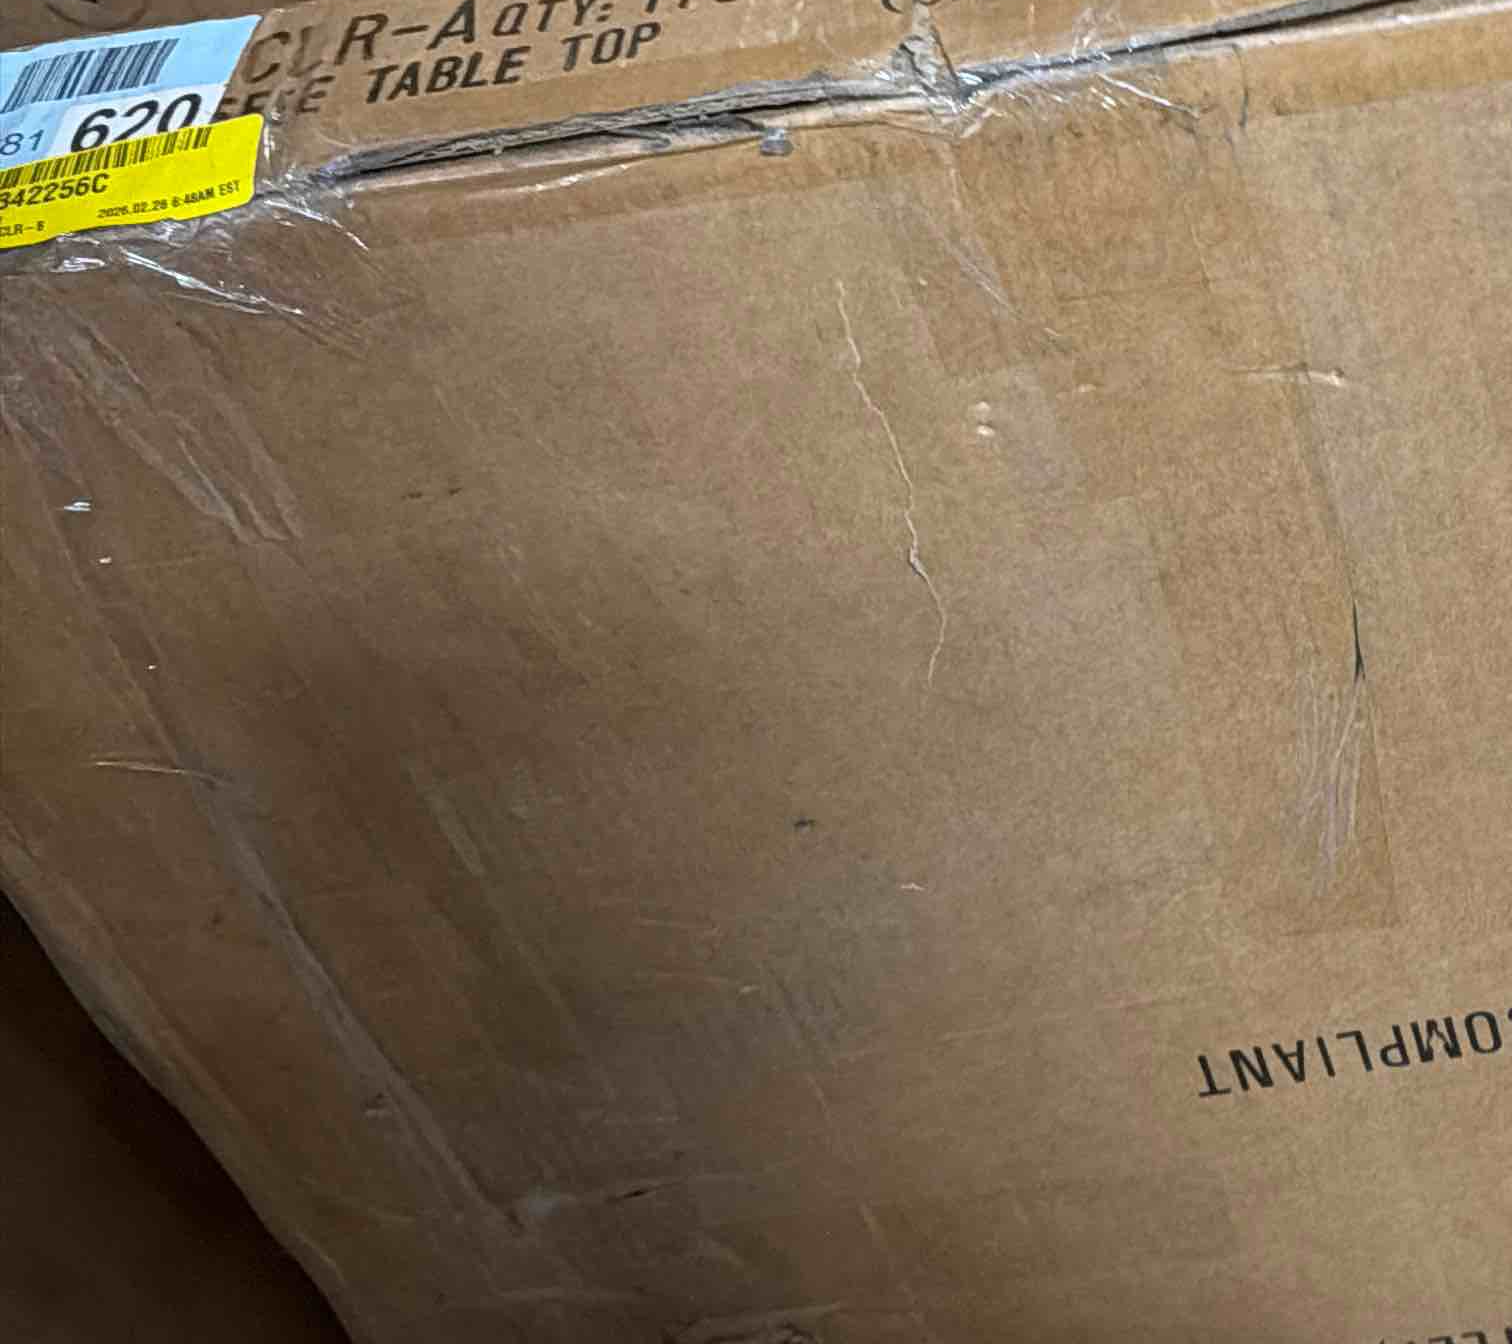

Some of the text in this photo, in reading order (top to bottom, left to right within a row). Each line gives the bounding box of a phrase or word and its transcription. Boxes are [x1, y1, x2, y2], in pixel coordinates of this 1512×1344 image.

[365, 46, 531, 104] TABLE
[561, 21, 663, 71] TOP
[0, 93, 202, 156] 81 620
